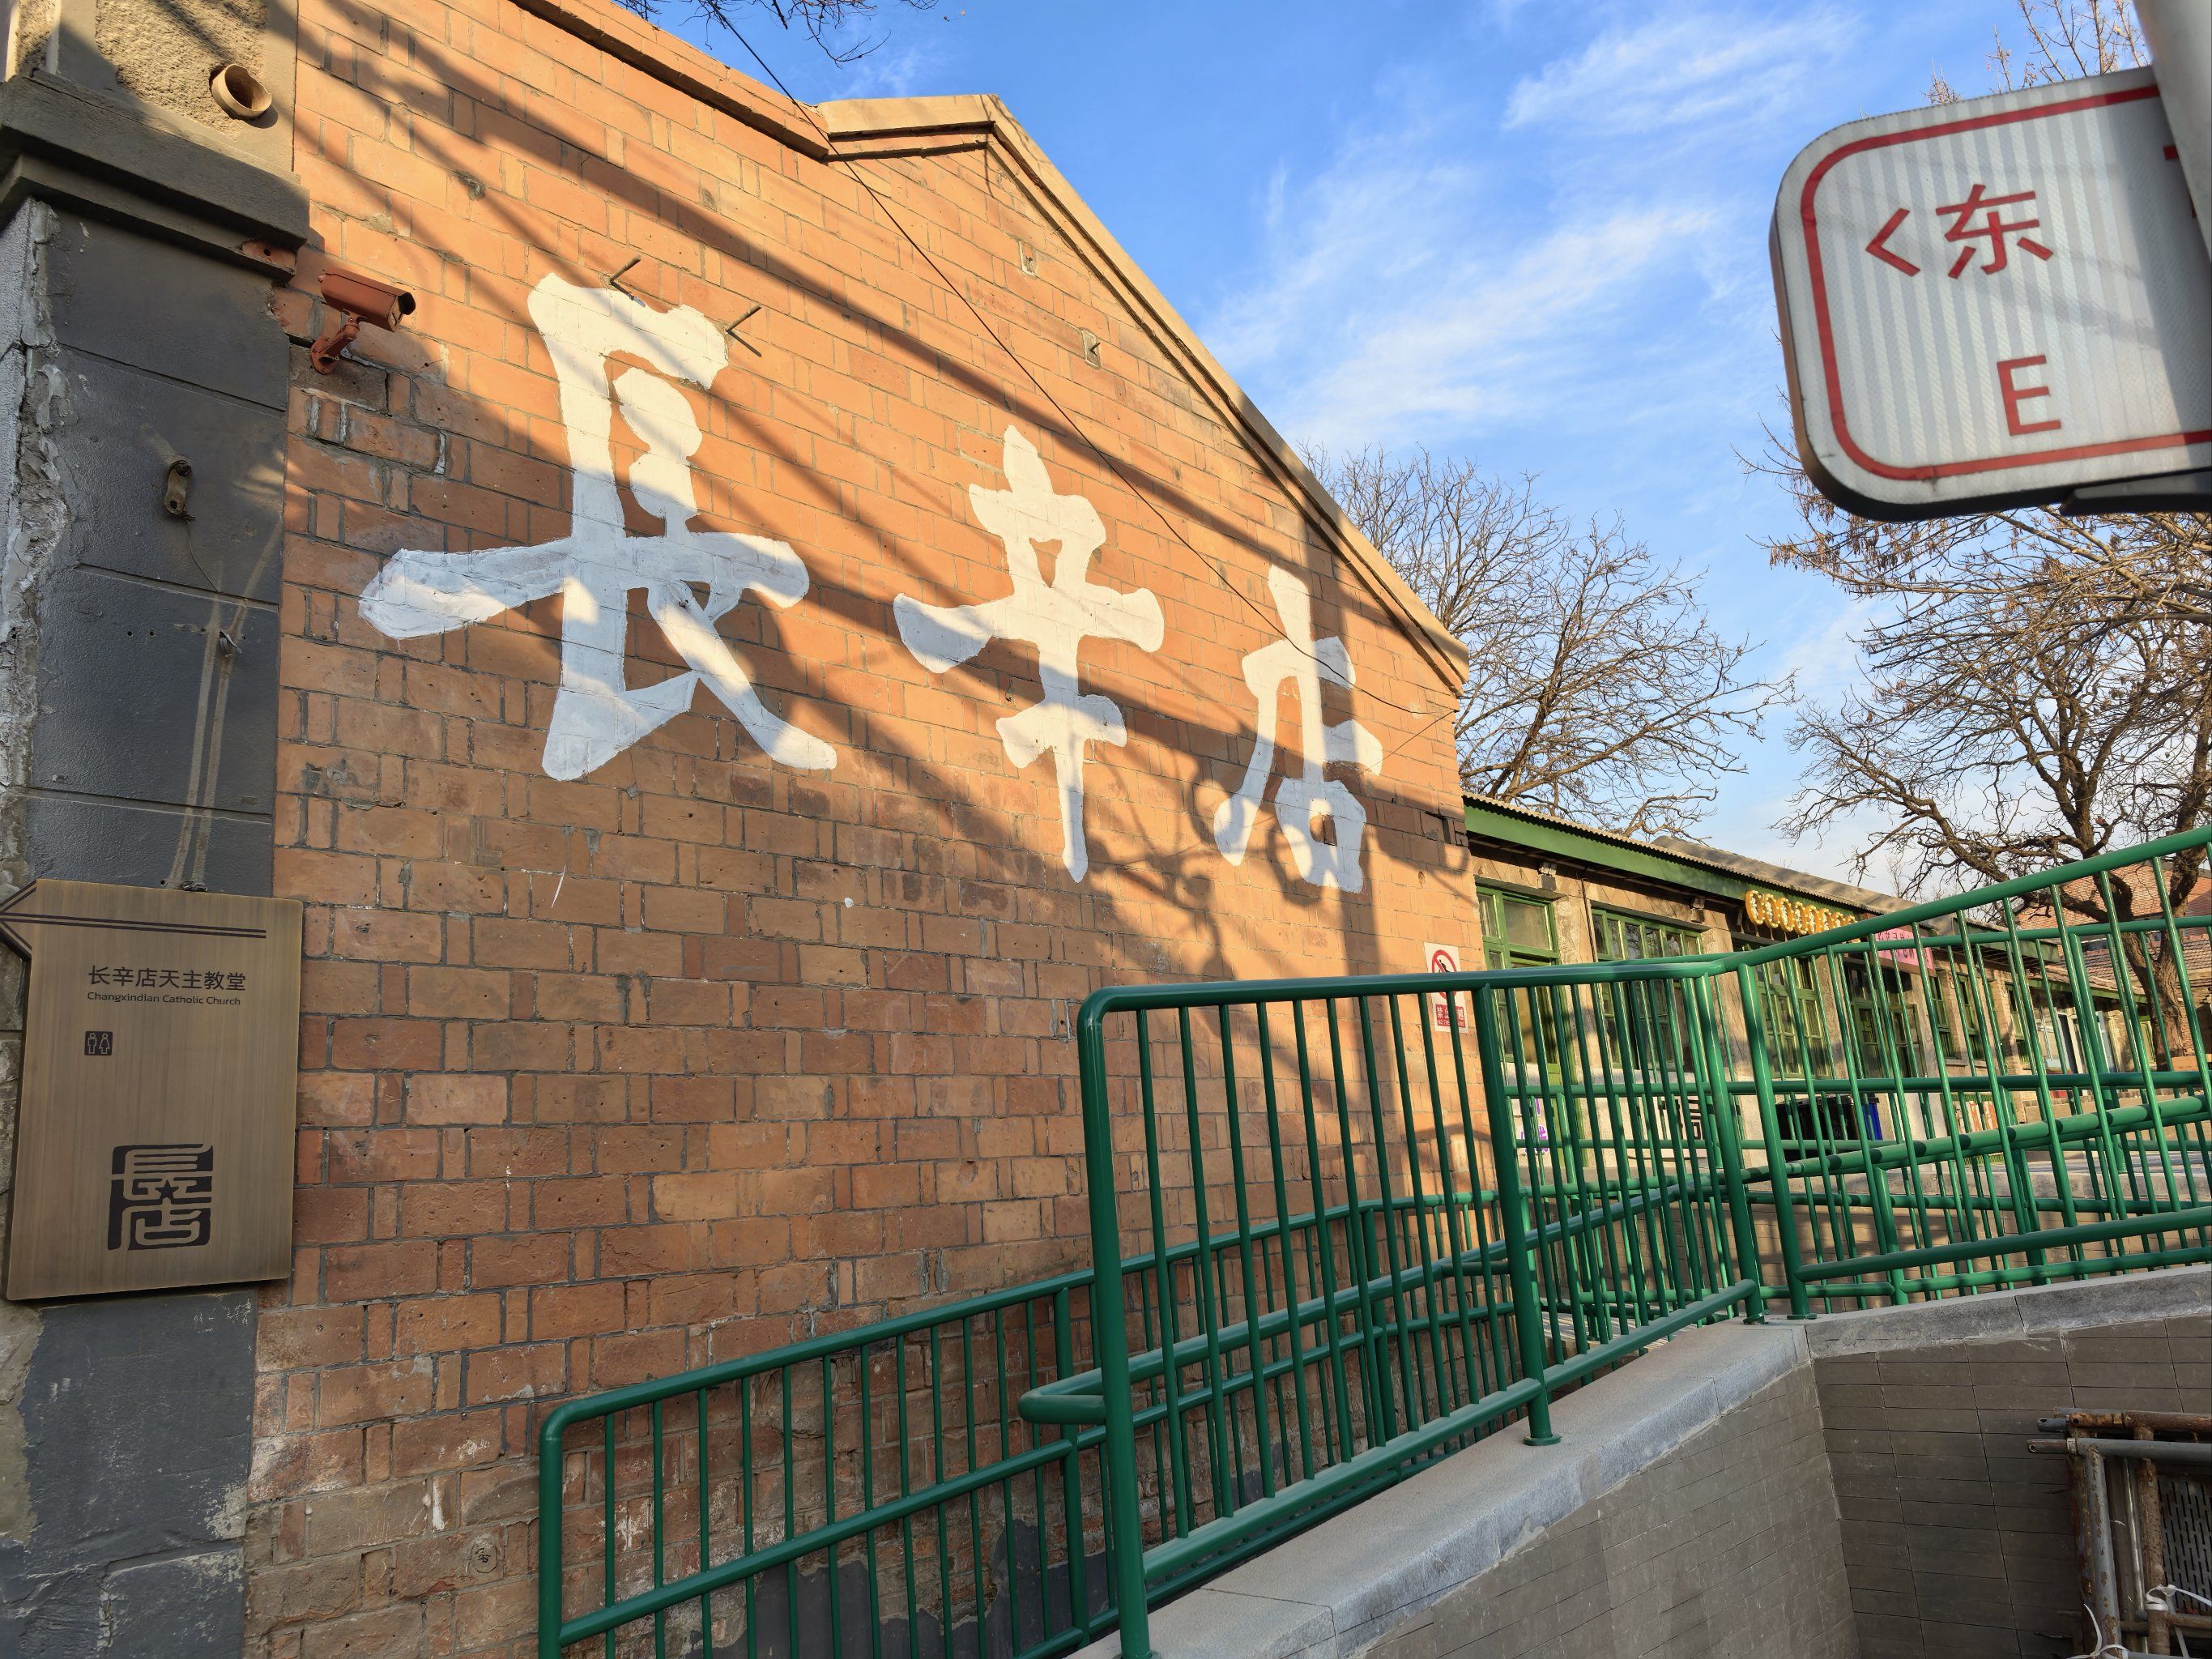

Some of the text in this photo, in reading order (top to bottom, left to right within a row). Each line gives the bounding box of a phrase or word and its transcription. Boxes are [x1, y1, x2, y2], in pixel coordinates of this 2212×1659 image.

[1936, 184, 2053, 279] 东
[1997, 355, 2062, 436] E
[87, 965, 246, 992] 长辛店天主教堂
[87, 992, 241, 1005] Changxindian Catholic Church
